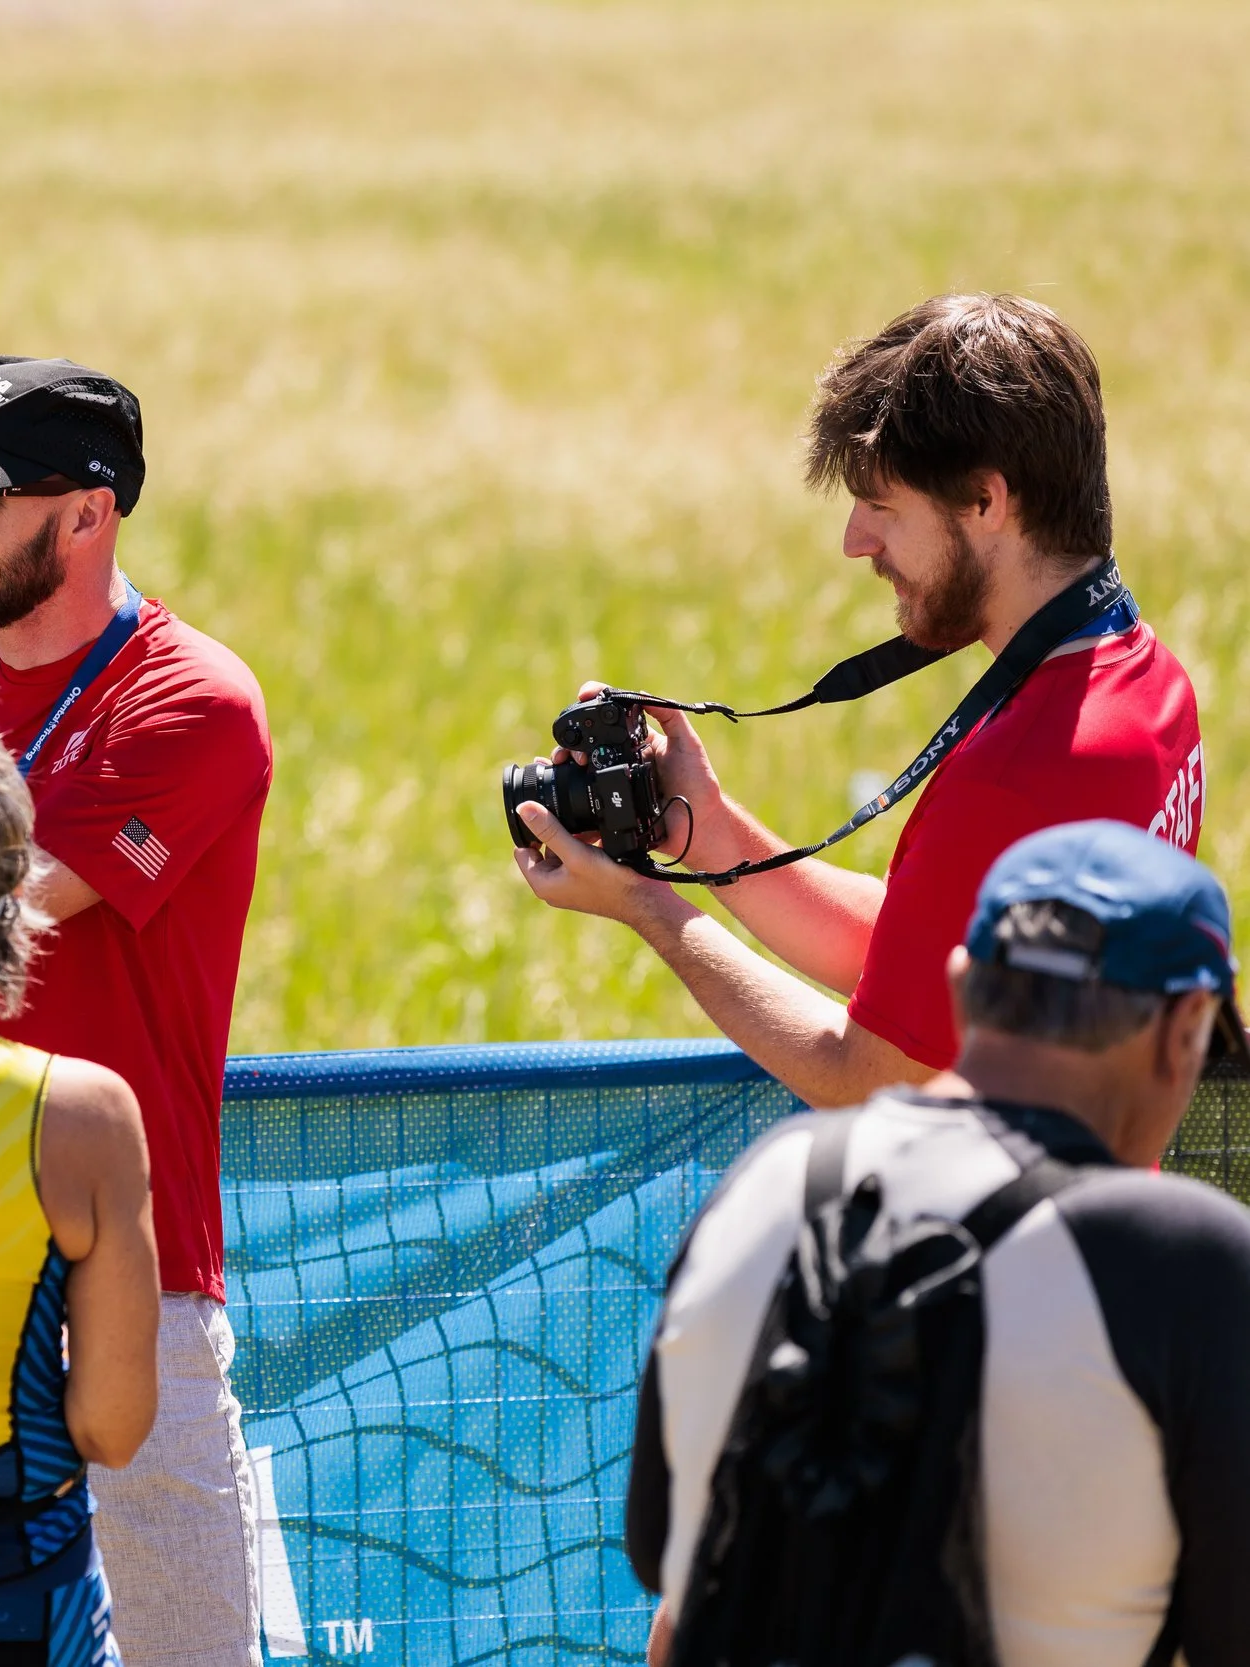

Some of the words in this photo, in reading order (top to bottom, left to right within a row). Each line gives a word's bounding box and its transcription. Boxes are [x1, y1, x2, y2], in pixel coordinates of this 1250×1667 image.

[1085, 565, 1121, 607] ONY
[53, 686, 82, 724] Oriental
[25, 727, 52, 761] Trading
[893, 715, 960, 794] SONY
[322, 1617, 375, 1656] TM
